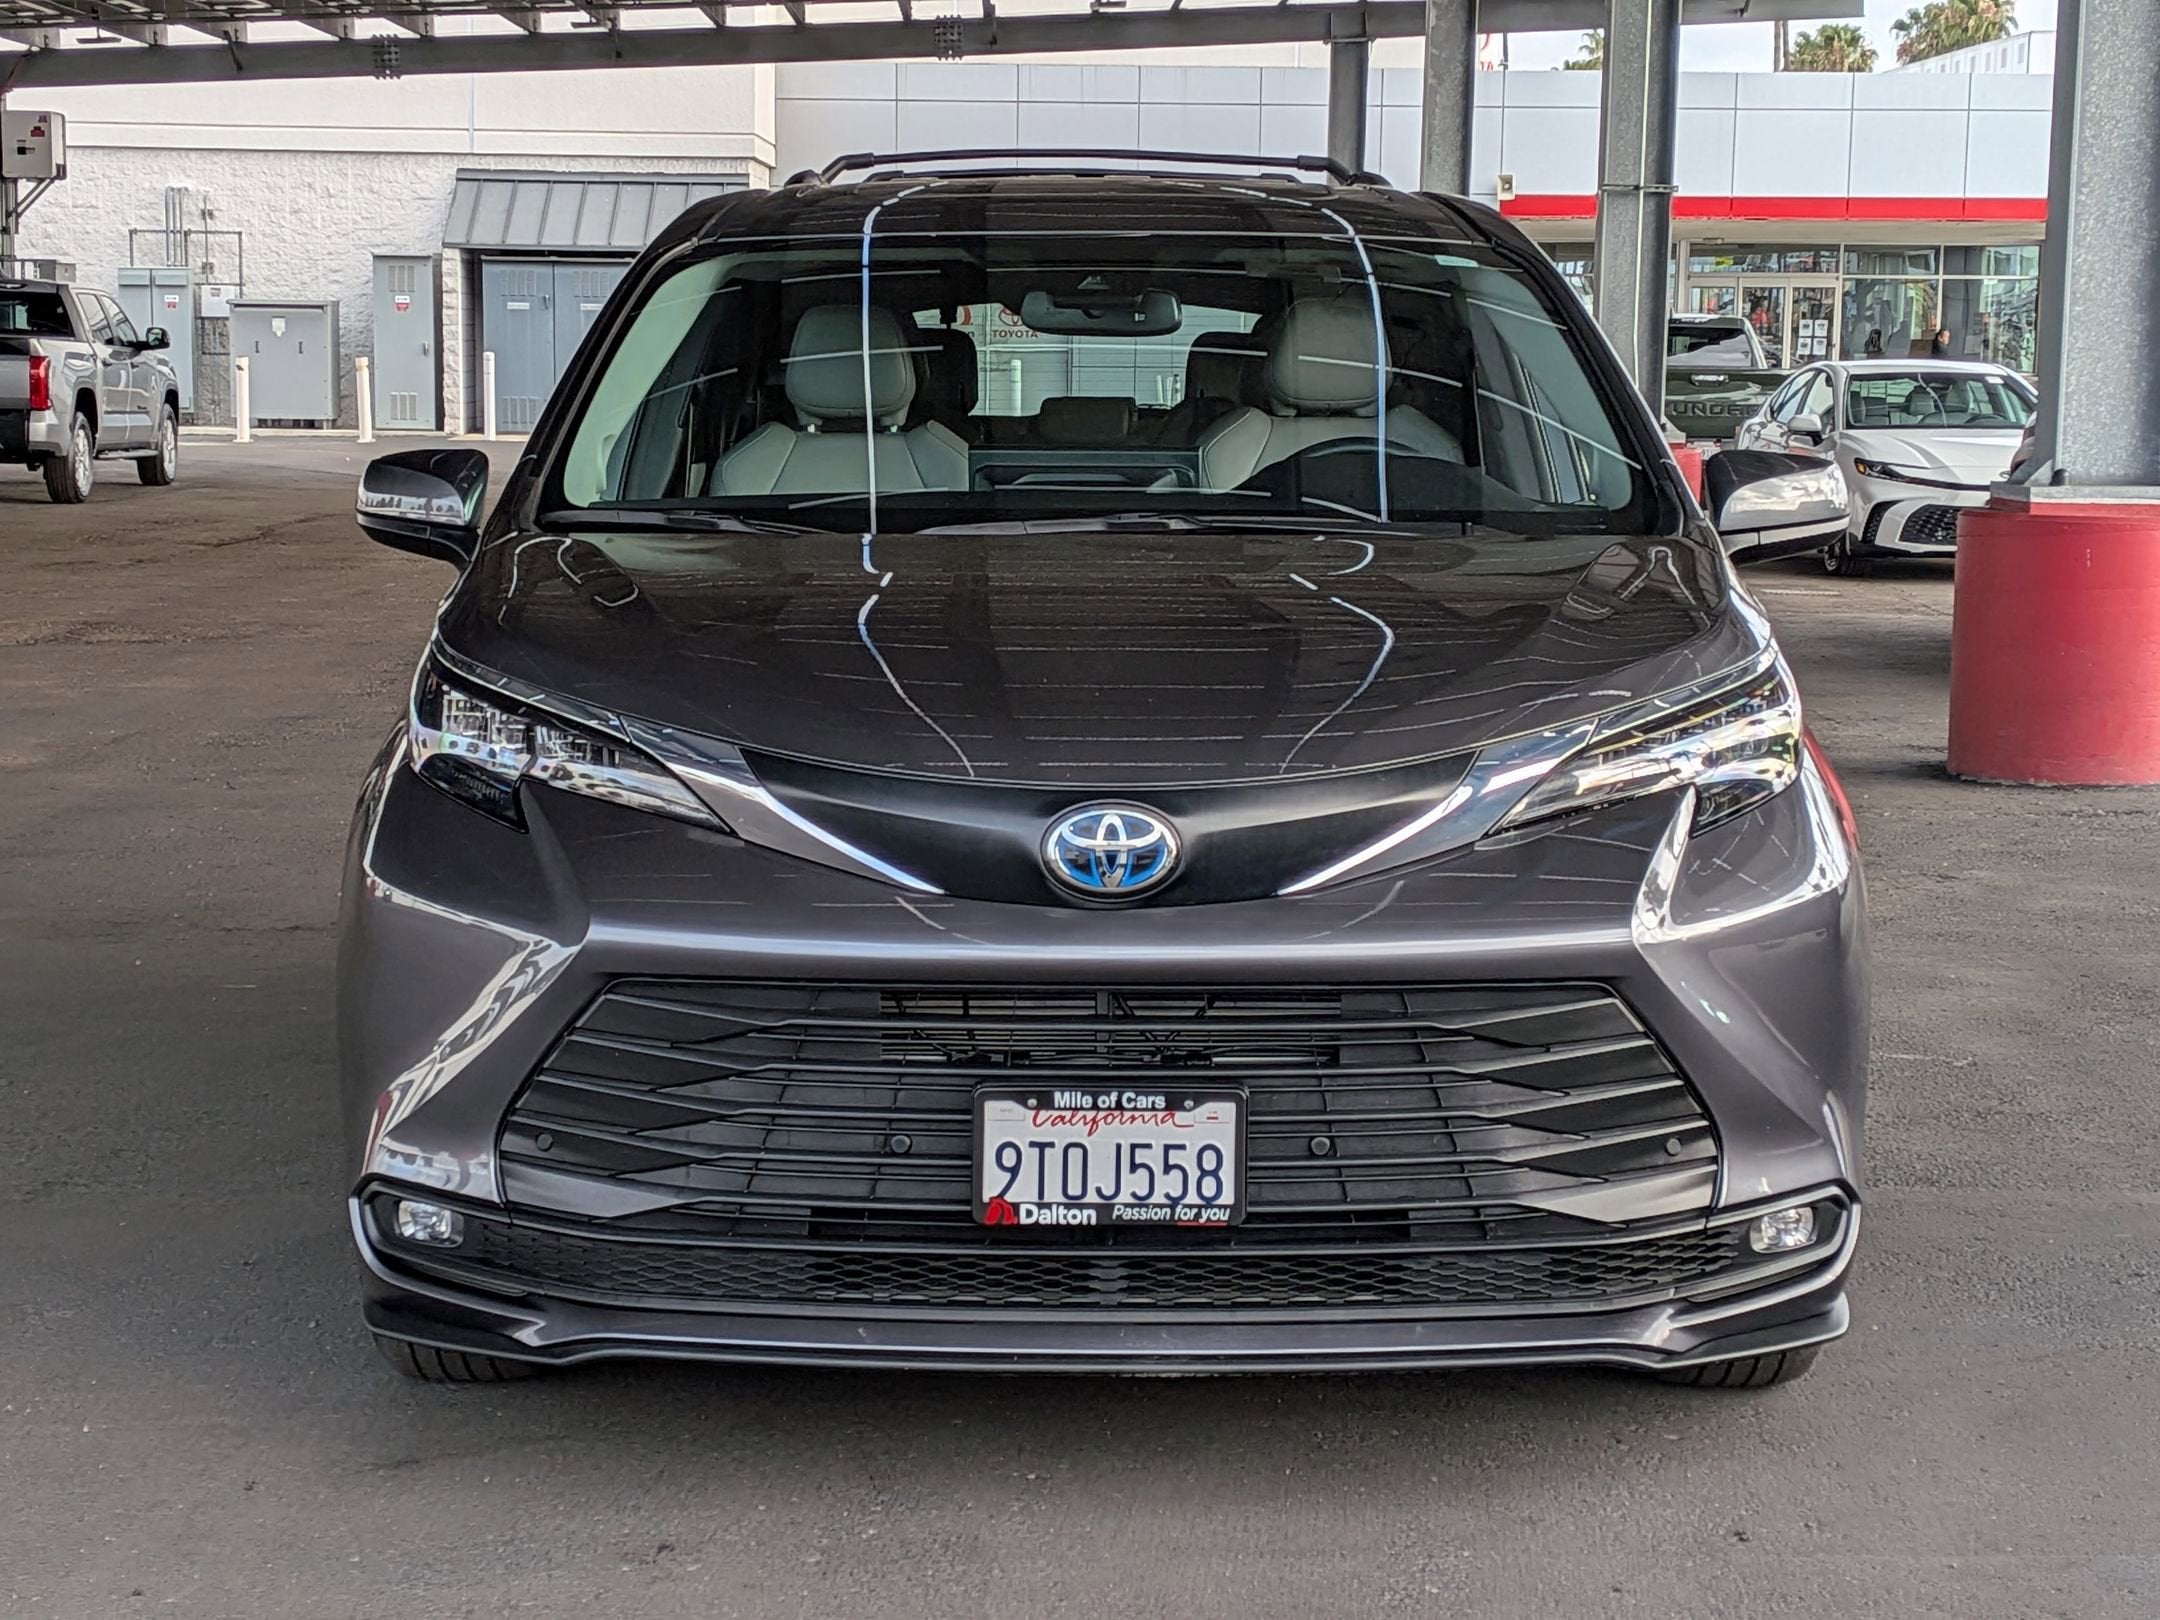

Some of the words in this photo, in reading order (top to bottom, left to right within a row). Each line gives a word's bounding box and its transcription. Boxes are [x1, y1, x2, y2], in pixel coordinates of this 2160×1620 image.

[992, 329, 1039, 339] TOYOTA
[1053, 1091, 1093, 1109] Mile
[1097, 1091, 1119, 1109] of
[1121, 1091, 1167, 1109] Cars
[1031, 1109, 1194, 1137] California
[1019, 1203, 1097, 1225] Dalton
[1112, 1204, 1171, 1222] Passion
[1173, 1205, 1198, 1222] for
[1198, 1207, 1230, 1223] you
